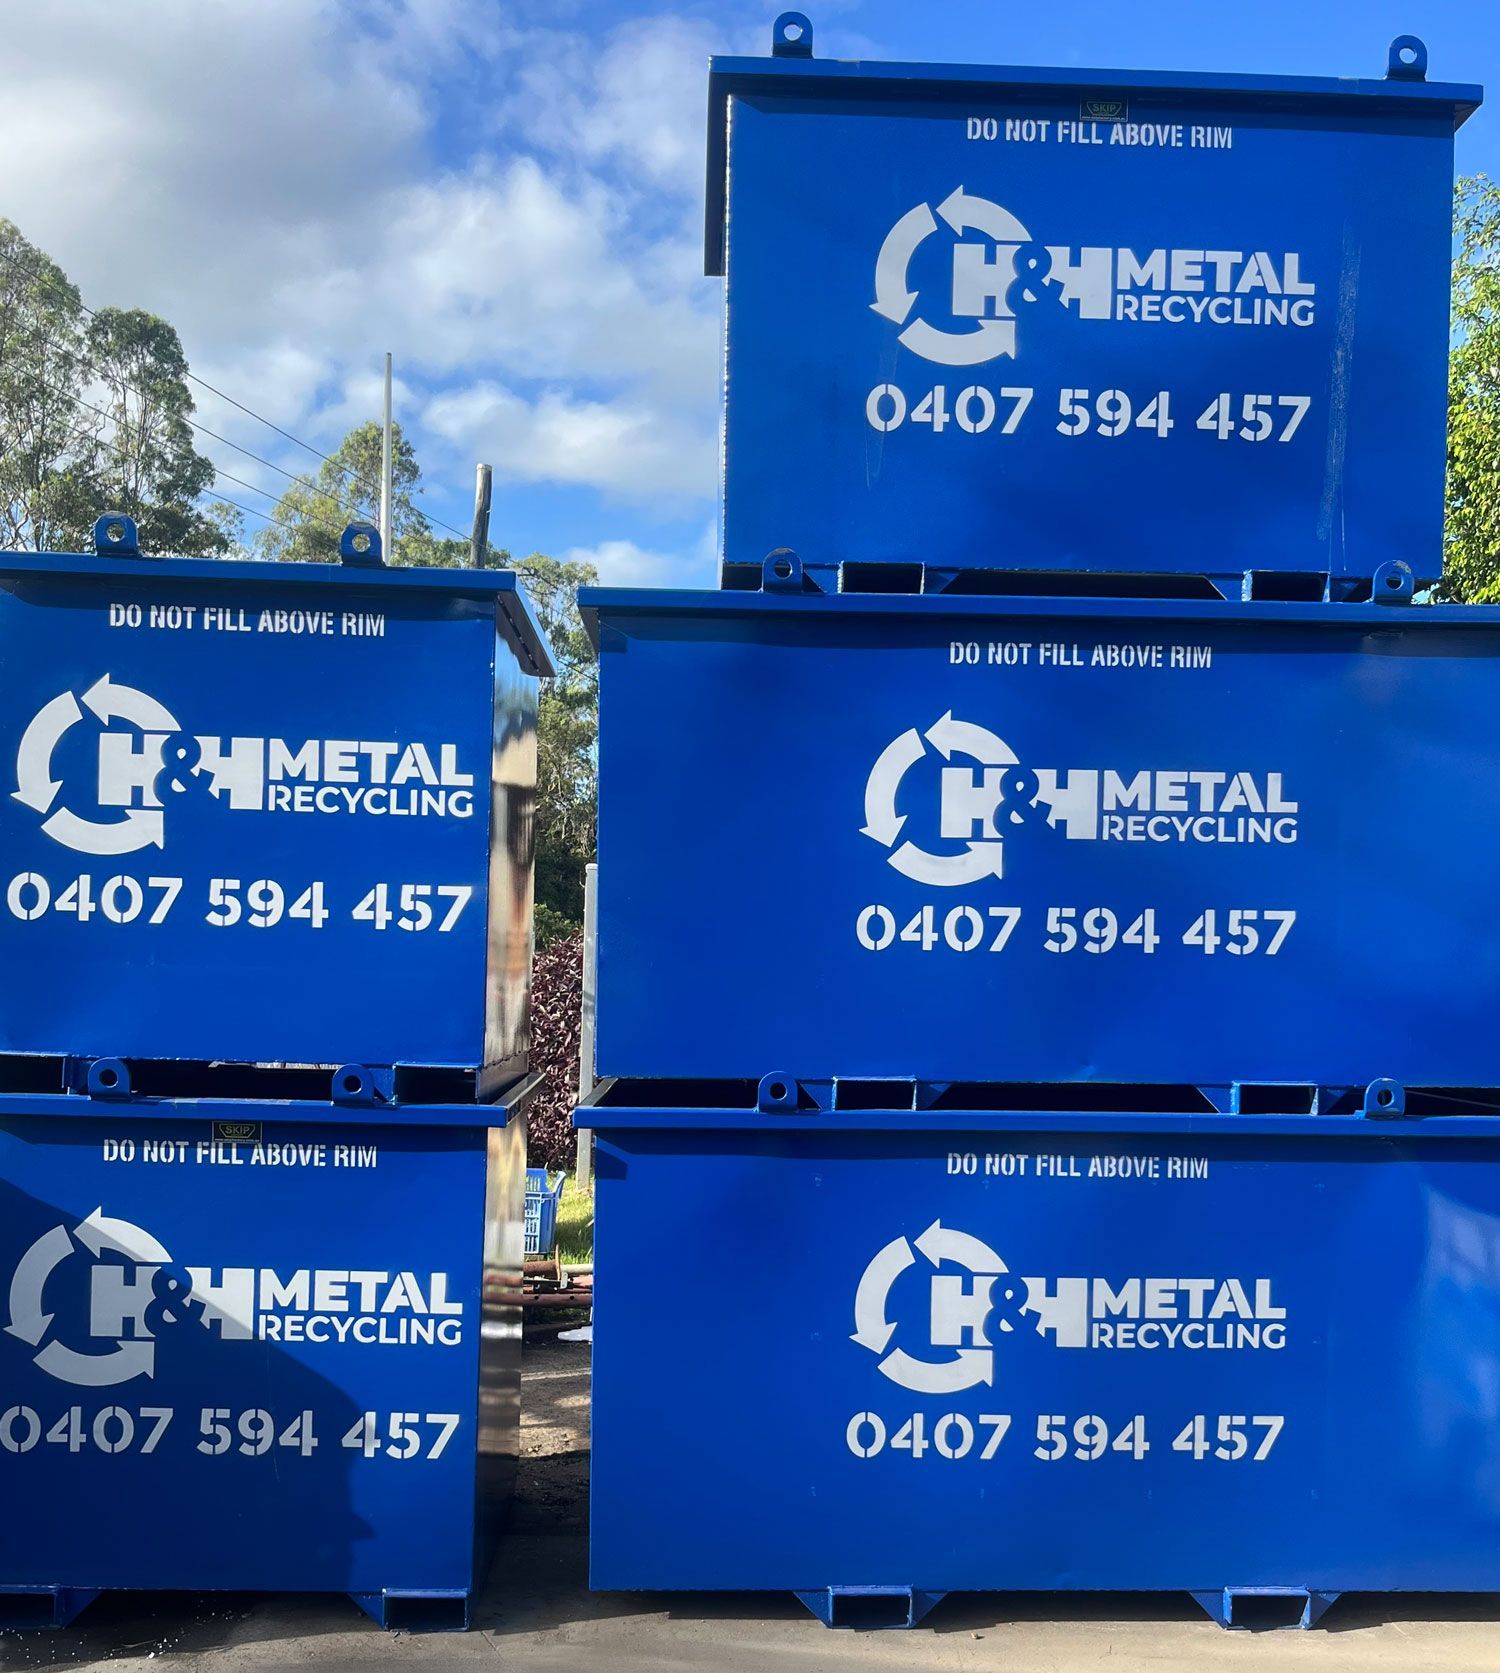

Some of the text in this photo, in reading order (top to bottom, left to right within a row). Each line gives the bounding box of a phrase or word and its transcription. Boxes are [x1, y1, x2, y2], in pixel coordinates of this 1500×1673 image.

[1092, 103, 1116, 113] SKIP
[967, 118, 1232, 148] DO NOT FILL ABOVE RIM
[953, 244, 1315, 319] H&H METAL
[1116, 295, 1314, 326] RECYCLING
[866, 384, 1311, 442] 0407 594 457
[110, 603, 384, 636] DO NOT FILL ABOVE RIM
[950, 642, 1211, 668] DO NOT FILL ABOVE RIM
[98, 733, 473, 810] H&H METAL
[268, 785, 473, 818] RECYCLING
[941, 767, 1298, 840] H&H METAL
[1103, 816, 1297, 843] RECYCLING
[7, 872, 474, 932] 0407 594 457
[856, 905, 1296, 955] 0407 594 457
[225, 1125, 250, 1134] SKIP
[104, 1139, 376, 1167] DO NOT FILL ABOVE RIM
[947, 1153, 1208, 1178] DO NOT FILL ABOVE RIM
[91, 1265, 463, 1340] H&H METAL
[931, 1276, 1286, 1348] H&H METAL
[259, 1315, 461, 1345] RECYCLING
[1092, 1323, 1286, 1349] RECYCLING
[0, 1406, 460, 1459] 0407 594 457
[846, 1412, 1284, 1460] 0407 594 457
